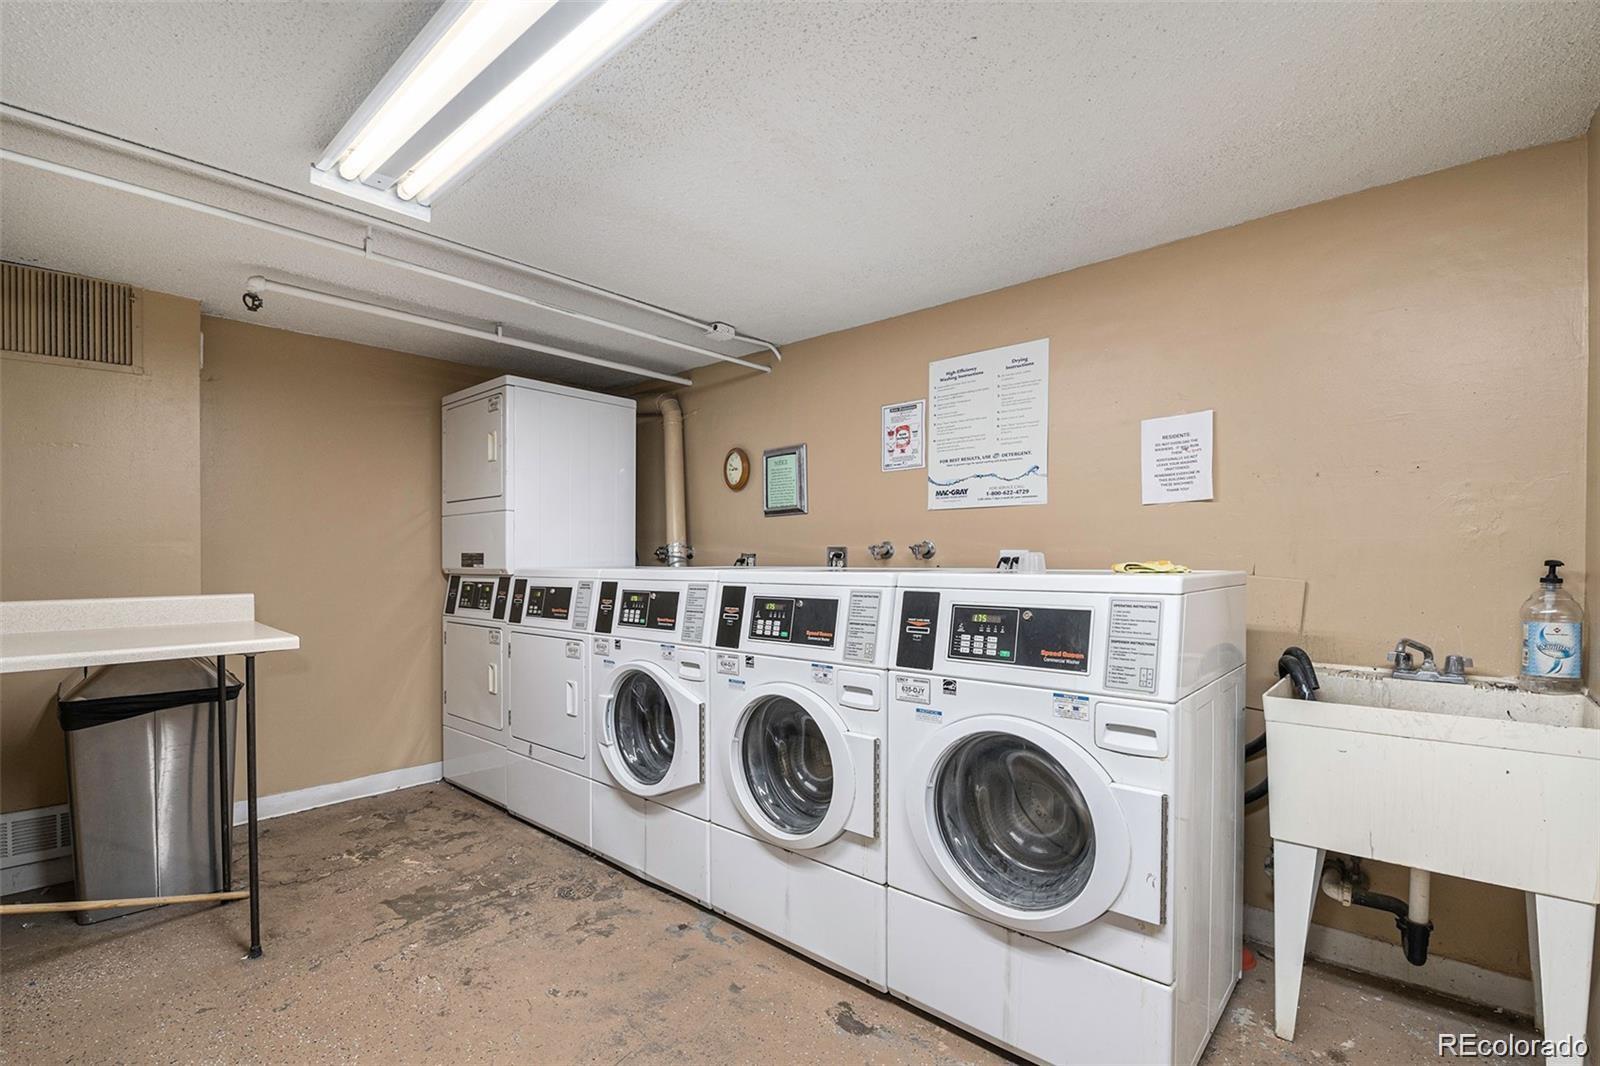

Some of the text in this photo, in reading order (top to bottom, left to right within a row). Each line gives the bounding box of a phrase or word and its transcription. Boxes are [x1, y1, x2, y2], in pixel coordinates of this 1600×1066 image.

[1011, 357, 1029, 365] Drying
[1005, 362, 1035, 370] Instructions
[958, 370, 984, 378] Instructions
[1040, 649, 1085, 659] Speed Queen
